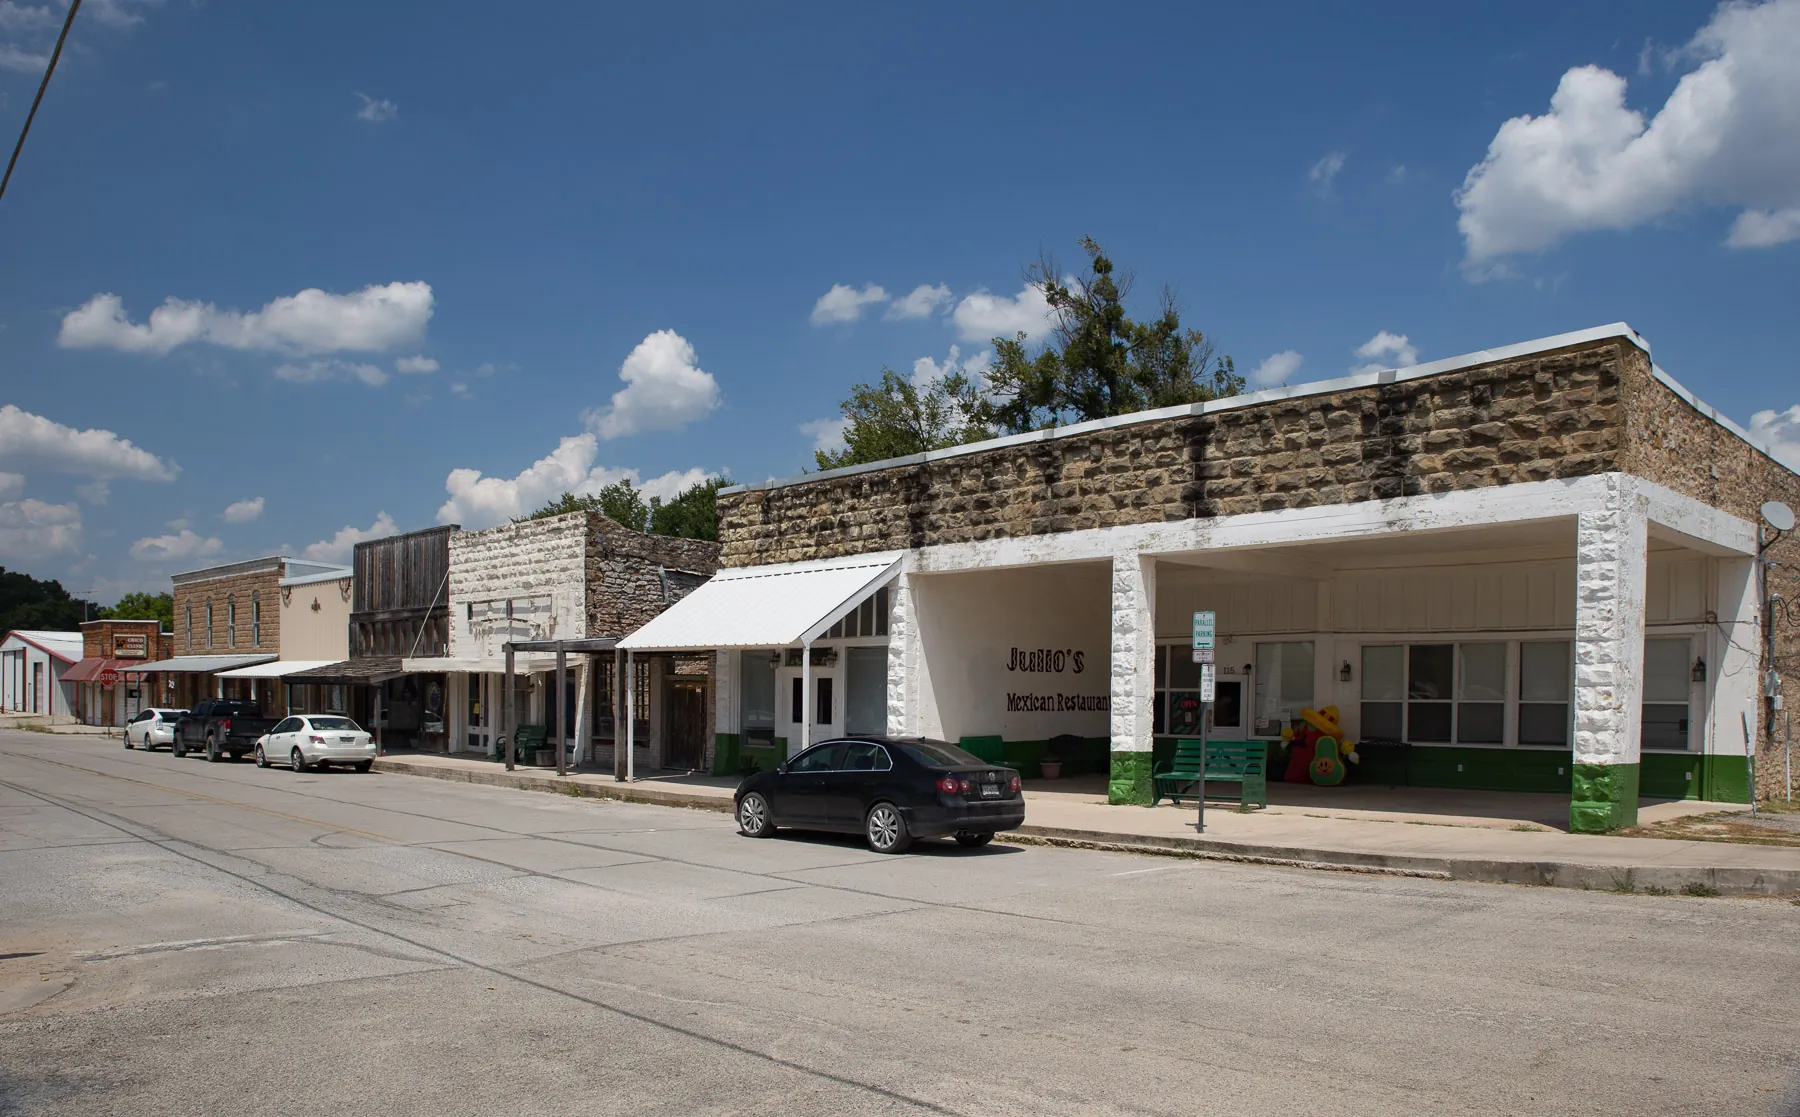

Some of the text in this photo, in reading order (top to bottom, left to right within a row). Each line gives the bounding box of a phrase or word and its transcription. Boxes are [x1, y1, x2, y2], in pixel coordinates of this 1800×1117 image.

[1195, 630, 1212, 638] PARKING
[1224, 666, 1235, 674] 115
[1006, 692, 1055, 712] Mexican
[1180, 700, 1198, 708] OPEN
